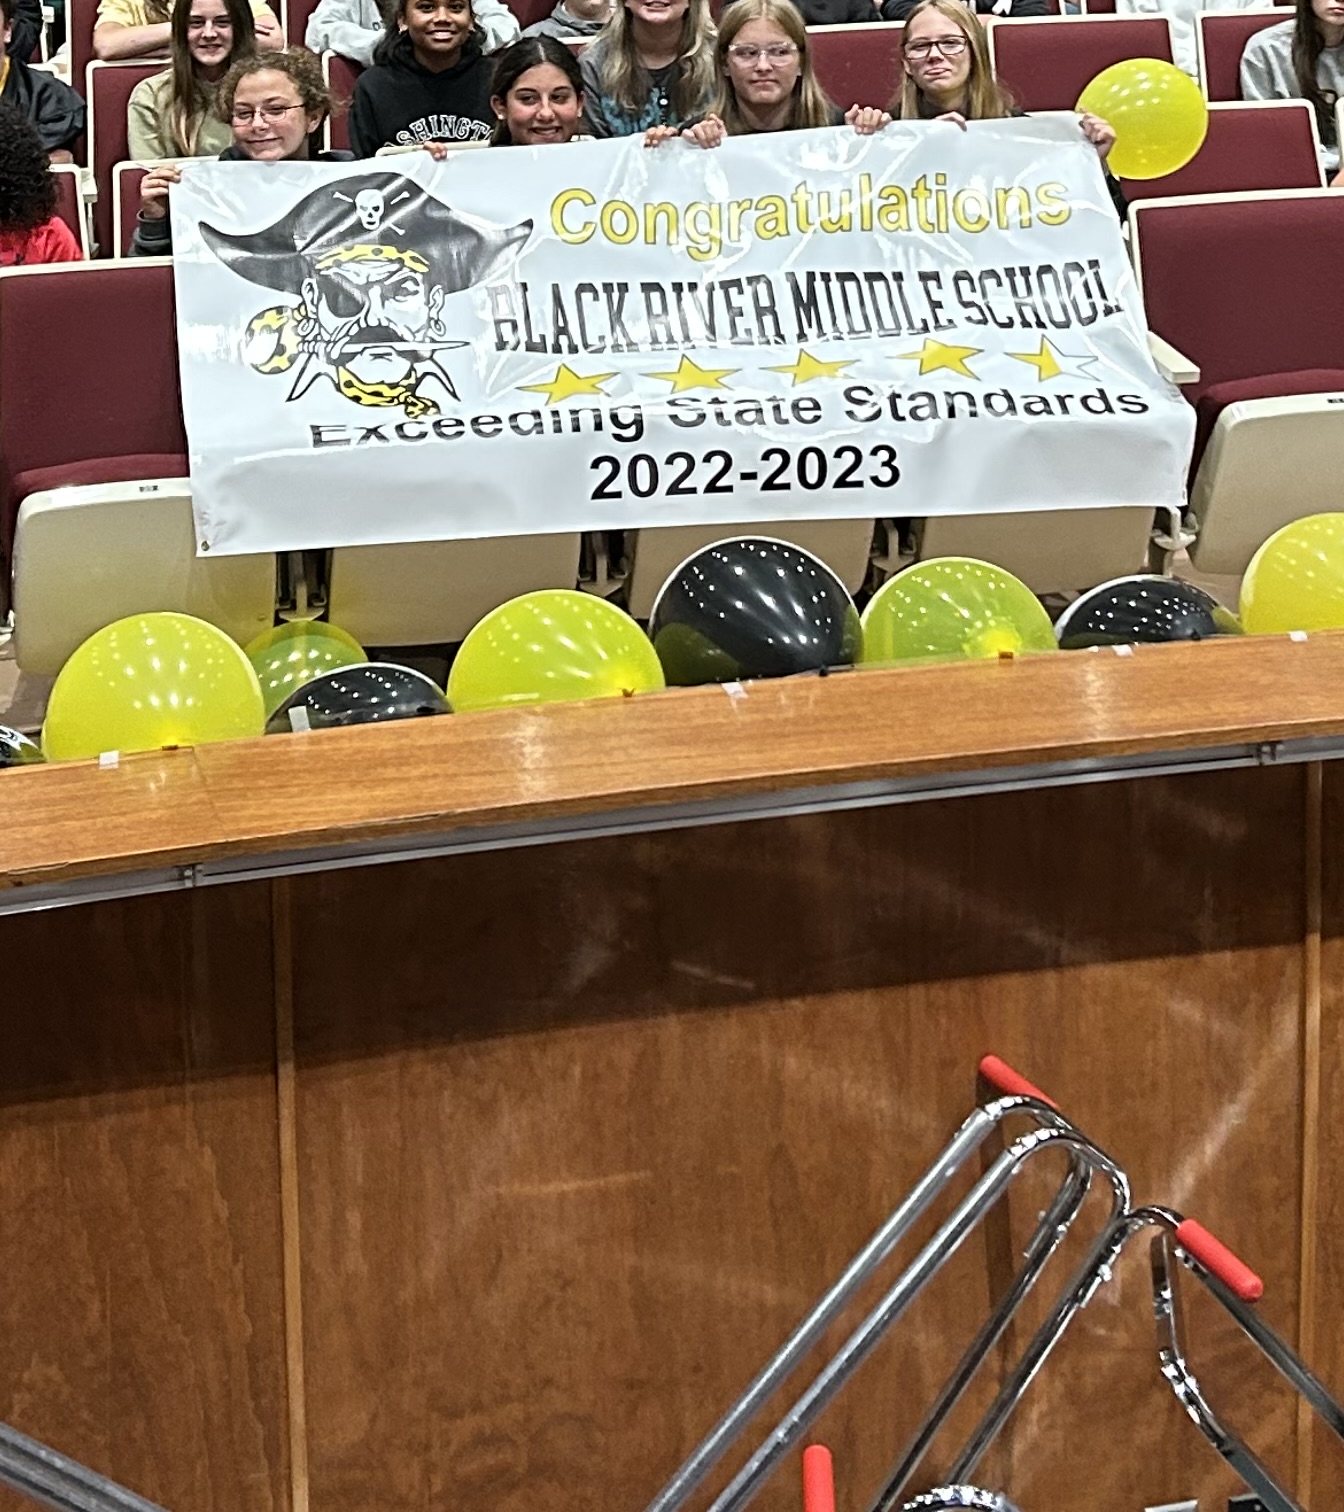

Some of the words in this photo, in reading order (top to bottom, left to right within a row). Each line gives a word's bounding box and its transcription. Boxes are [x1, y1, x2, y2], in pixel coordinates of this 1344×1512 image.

[384, 115, 494, 146] SHINGT
[549, 173, 1074, 262] Congratulations
[487, 282, 639, 354] BLACK
[640, 274, 786, 351] RIVER
[785, 270, 958, 342] MIDDLE
[953, 259, 1124, 330] SCHOOL
[309, 403, 645, 449] Exceeding
[666, 394, 822, 428] State
[843, 385, 1150, 424] Standards
[589, 444, 901, 501] 2022-2023
